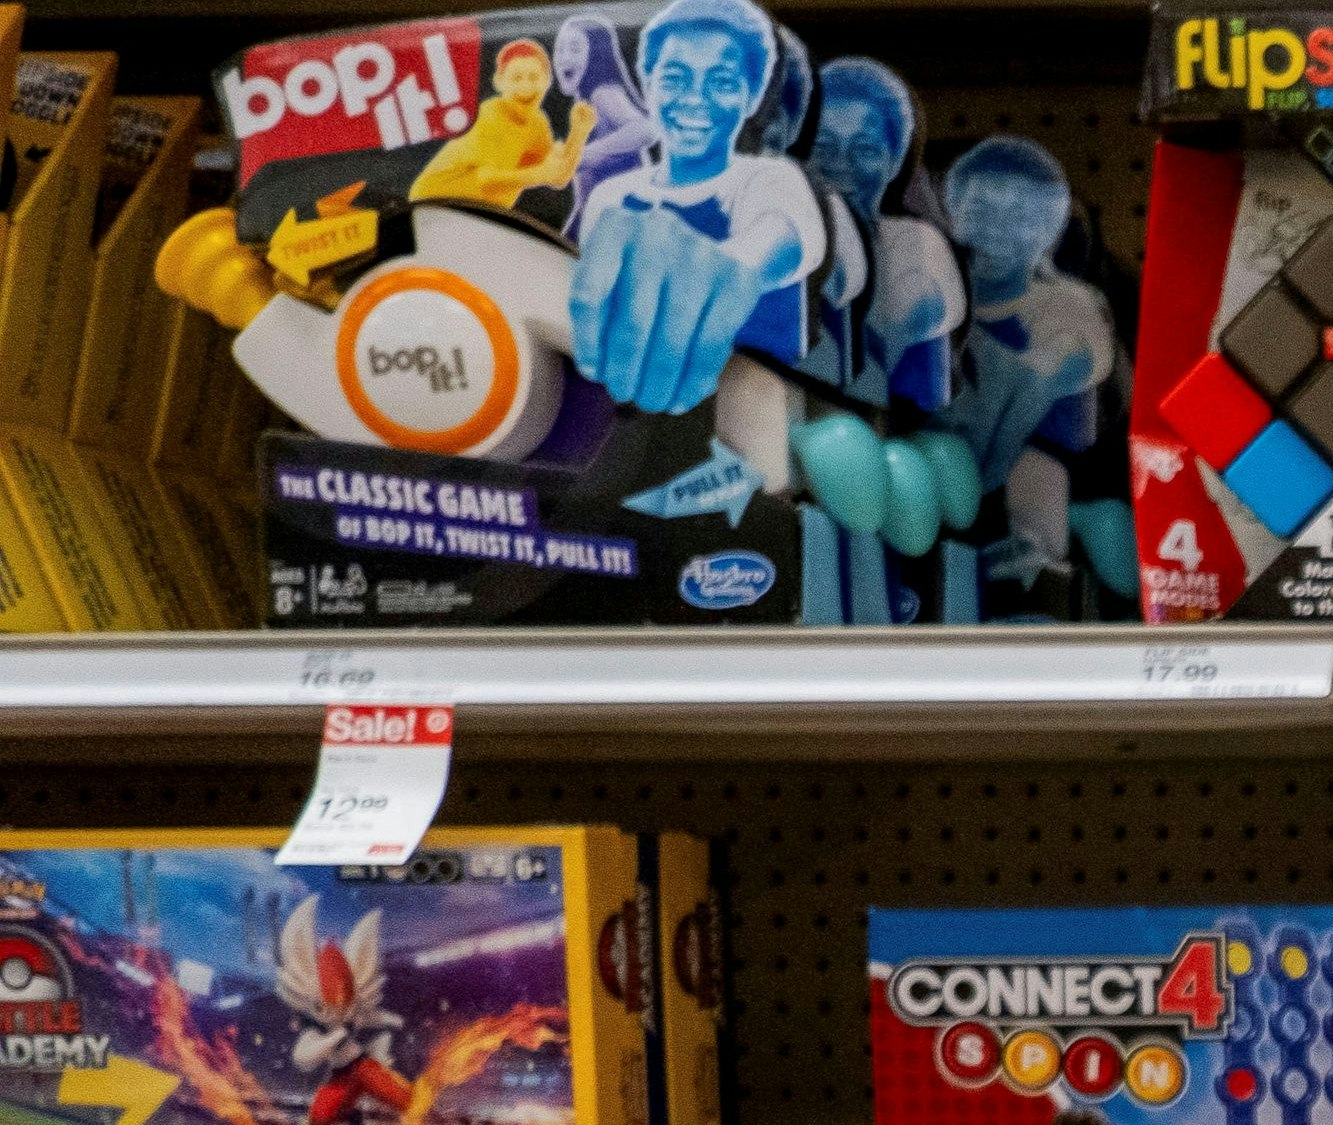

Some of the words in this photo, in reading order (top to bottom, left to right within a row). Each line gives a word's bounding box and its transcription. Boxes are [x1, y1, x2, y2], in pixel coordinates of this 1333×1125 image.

[222, 42, 396, 141] bop
[373, 33, 470, 152] it!
[368, 346, 437, 383] bop
[279, 473, 316, 500] THE
[316, 467, 434, 516] CLASSIC
[437, 482, 528, 528] GAME
[364, 515, 412, 545] BOP
[445, 525, 511, 559] TWIST
[545, 537, 600, 571] PULL
[1156, 517, 1205, 573] 4
[1292, 600, 1315, 617] to
[325, 707, 418, 743] Sale!
[897, 964, 1163, 1019] CONNECT
[1157, 941, 1226, 1030] 4
[0, 1033, 110, 1070] DEMY
